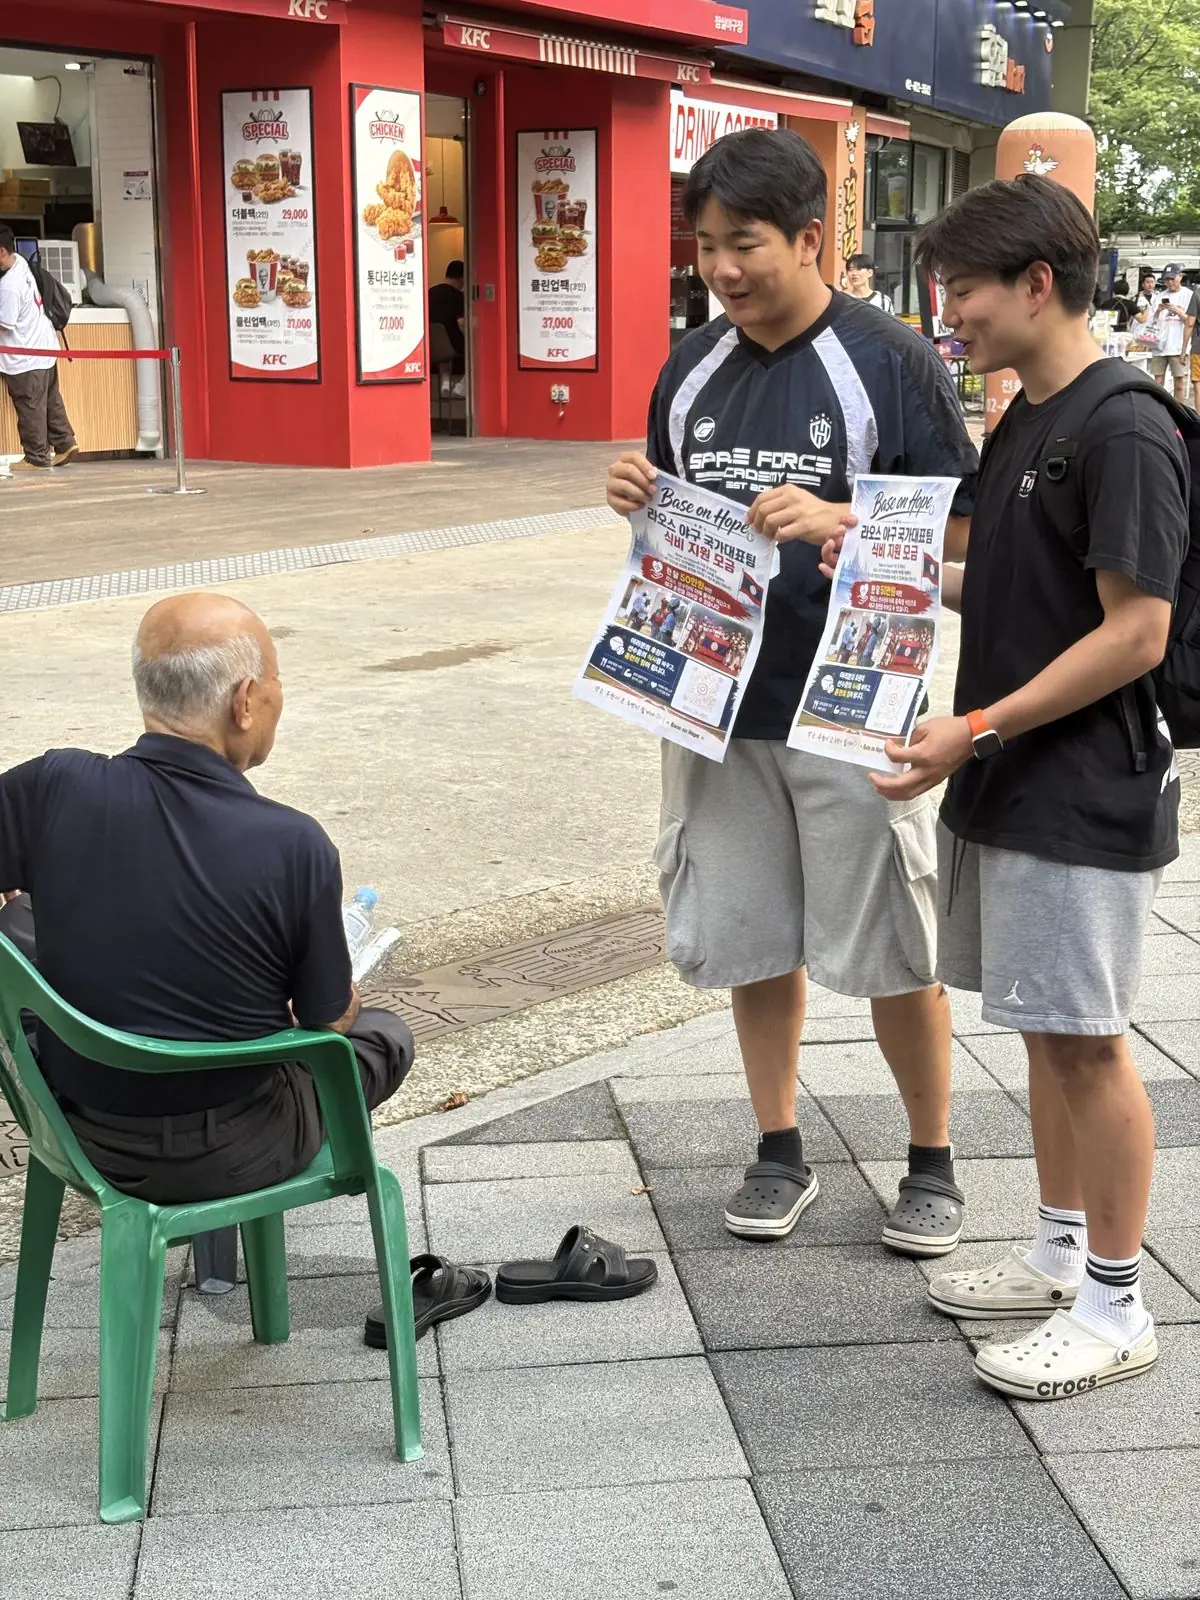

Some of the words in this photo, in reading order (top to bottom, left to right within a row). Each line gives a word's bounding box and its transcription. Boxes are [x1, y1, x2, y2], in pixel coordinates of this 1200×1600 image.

[288, 0, 328, 20] KFC
[460, 26, 490, 49] KFC
[676, 64, 700, 82] KFC
[244, 122, 286, 138] SPECIAL
[371, 123, 404, 140] CHICKEN
[674, 104, 720, 160] DRINK
[536, 158, 574, 170] SPECIAL
[282, 208, 308, 220] 29,000
[367, 270, 414, 286] 통다리순살팩
[286, 318, 312, 330] 37,000
[379, 316, 404, 331] 27,000
[542, 317, 574, 330] 37,000
[262, 353, 288, 365] KFC
[546, 348, 570, 358] KFC
[404, 362, 422, 374] KFC
[756, 450, 832, 474] FORCE
[726, 481, 748, 490] EST
[657, 487, 694, 514] Base
[696, 506, 712, 520] on
[714, 508, 749, 535] Hope
[870, 491, 896, 520] Base
[896, 496, 909, 510] on
[909, 489, 931, 518] Hope
[648, 508, 676, 532] 라오스
[680, 525, 700, 542] 야구
[704, 534, 756, 568] 국가대표팀
[861, 525, 882, 540] 라오스
[882, 526, 896, 542] 야구
[898, 527, 934, 544] 국가대표팀
[664, 532, 684, 552] 식비
[688, 541, 710, 560] 지원
[713, 552, 736, 574] 모금
[872, 542, 886, 559] 식비
[888, 544, 902, 560] 지원
[902, 545, 918, 562] 모금
[1047, 1238, 1080, 1252] adidas
[1036, 1374, 1098, 1396] crocs
